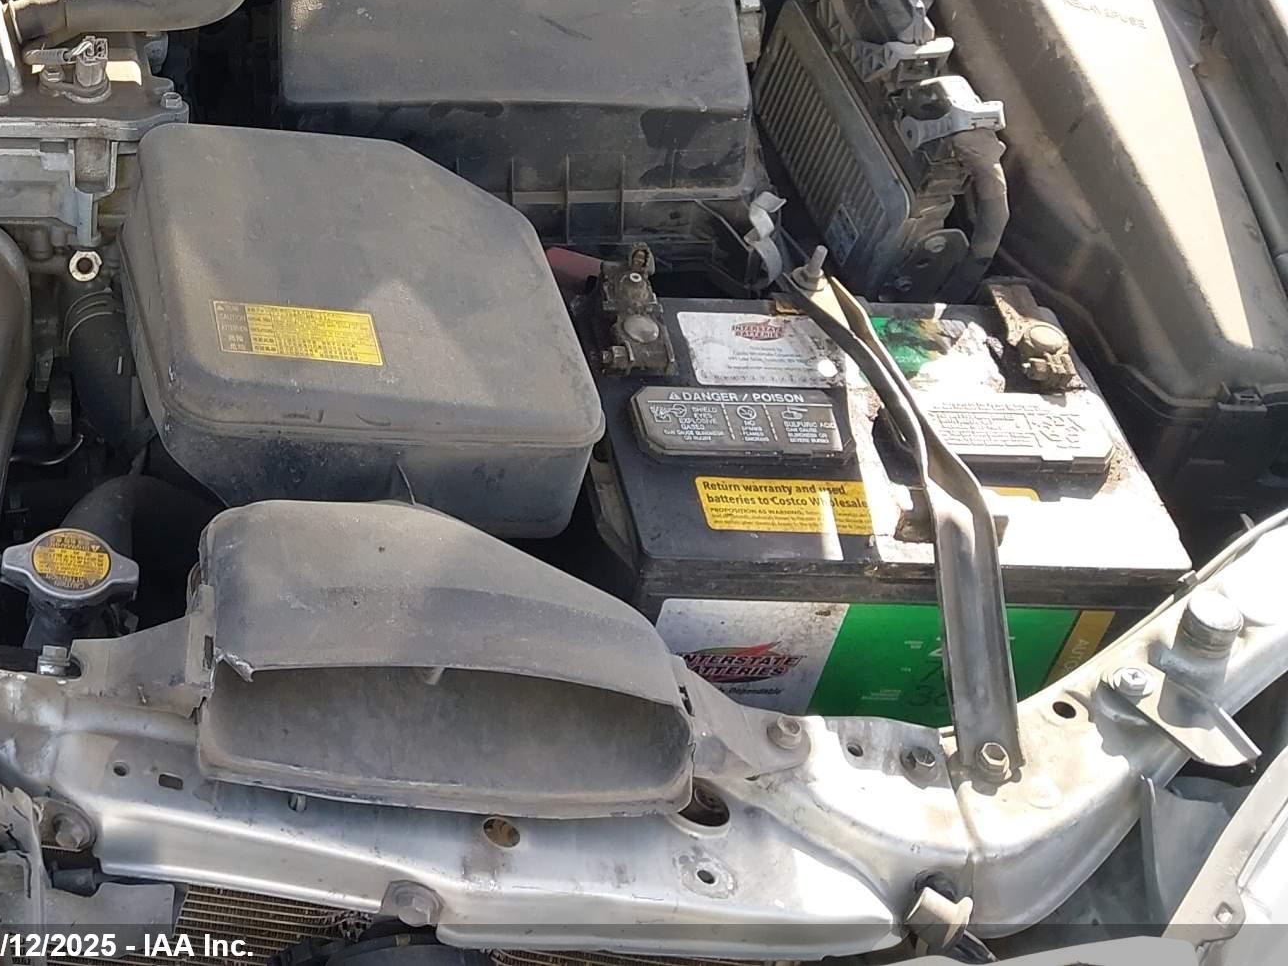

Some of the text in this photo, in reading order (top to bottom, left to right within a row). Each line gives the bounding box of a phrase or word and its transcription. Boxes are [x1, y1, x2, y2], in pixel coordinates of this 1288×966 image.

[682, 391, 739, 402] DANGER
[753, 393, 805, 403] POISON
[703, 481, 742, 492] Return
[745, 483, 792, 495] warranty
[795, 484, 817, 494] and
[707, 494, 756, 505] batteries
[757, 496, 769, 505] to
[771, 496, 808, 506] Costco
[675, 652, 801, 668] NTERSTATE
[691, 664, 788, 677] ATTERIES
